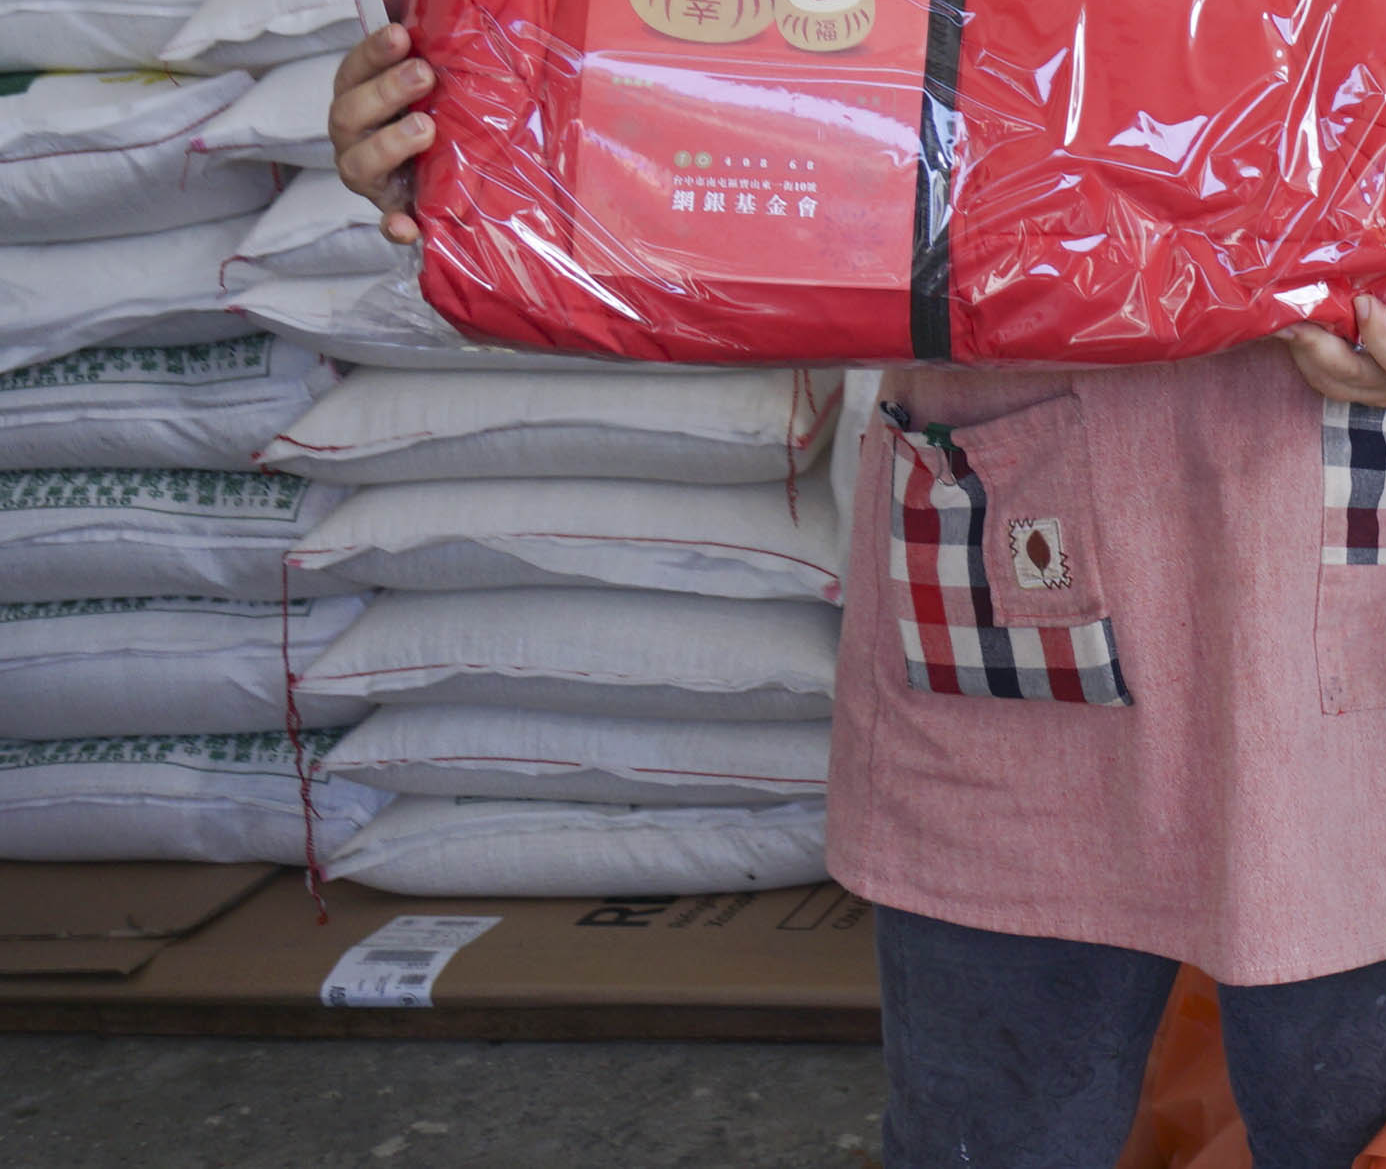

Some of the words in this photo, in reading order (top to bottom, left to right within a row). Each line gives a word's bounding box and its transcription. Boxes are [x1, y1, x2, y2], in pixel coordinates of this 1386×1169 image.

[815, 20, 838, 42] 福
[671, 189, 819, 218] 網銀基金會
